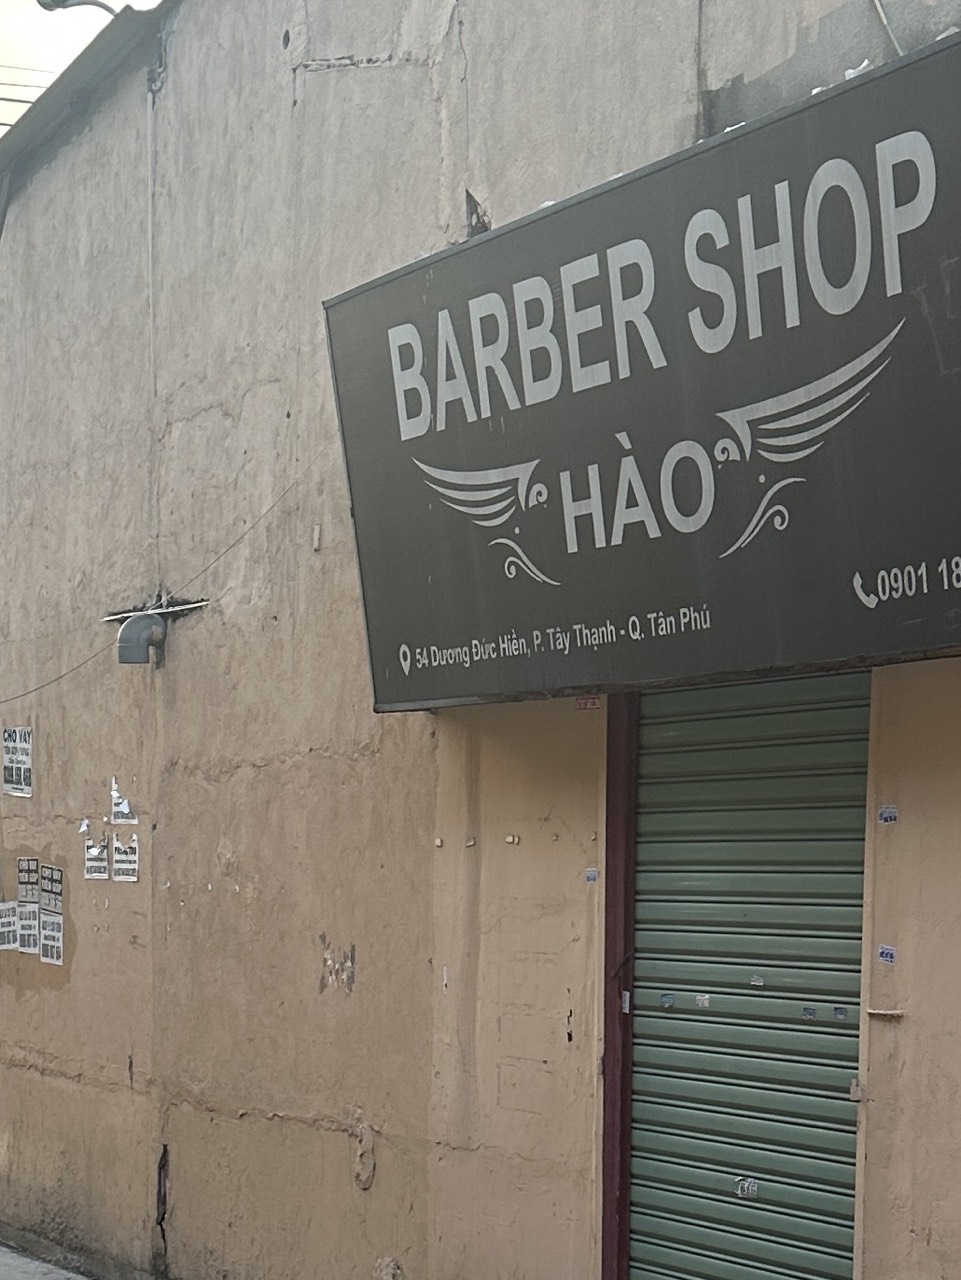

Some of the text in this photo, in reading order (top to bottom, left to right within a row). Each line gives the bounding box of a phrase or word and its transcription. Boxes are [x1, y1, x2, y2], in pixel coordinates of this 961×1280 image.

[387, 130, 937, 442] BARBER SHOP
[559, 431, 716, 554] HÀO
[877, 556, 961, 602] 0901 18
[415, 647, 430, 669] 54
[431, 644, 470, 668] Dương
[471, 638, 497, 662] Đức
[500, 629, 532, 659] Hiền,
[533, 630, 545, 653] P.
[546, 626, 572, 655] Tây
[573, 620, 617, 652] Thạnh
[628, 615, 645, 641] Q.
[647, 611, 677, 637] Tân
[679, 603, 711, 633] Phú
